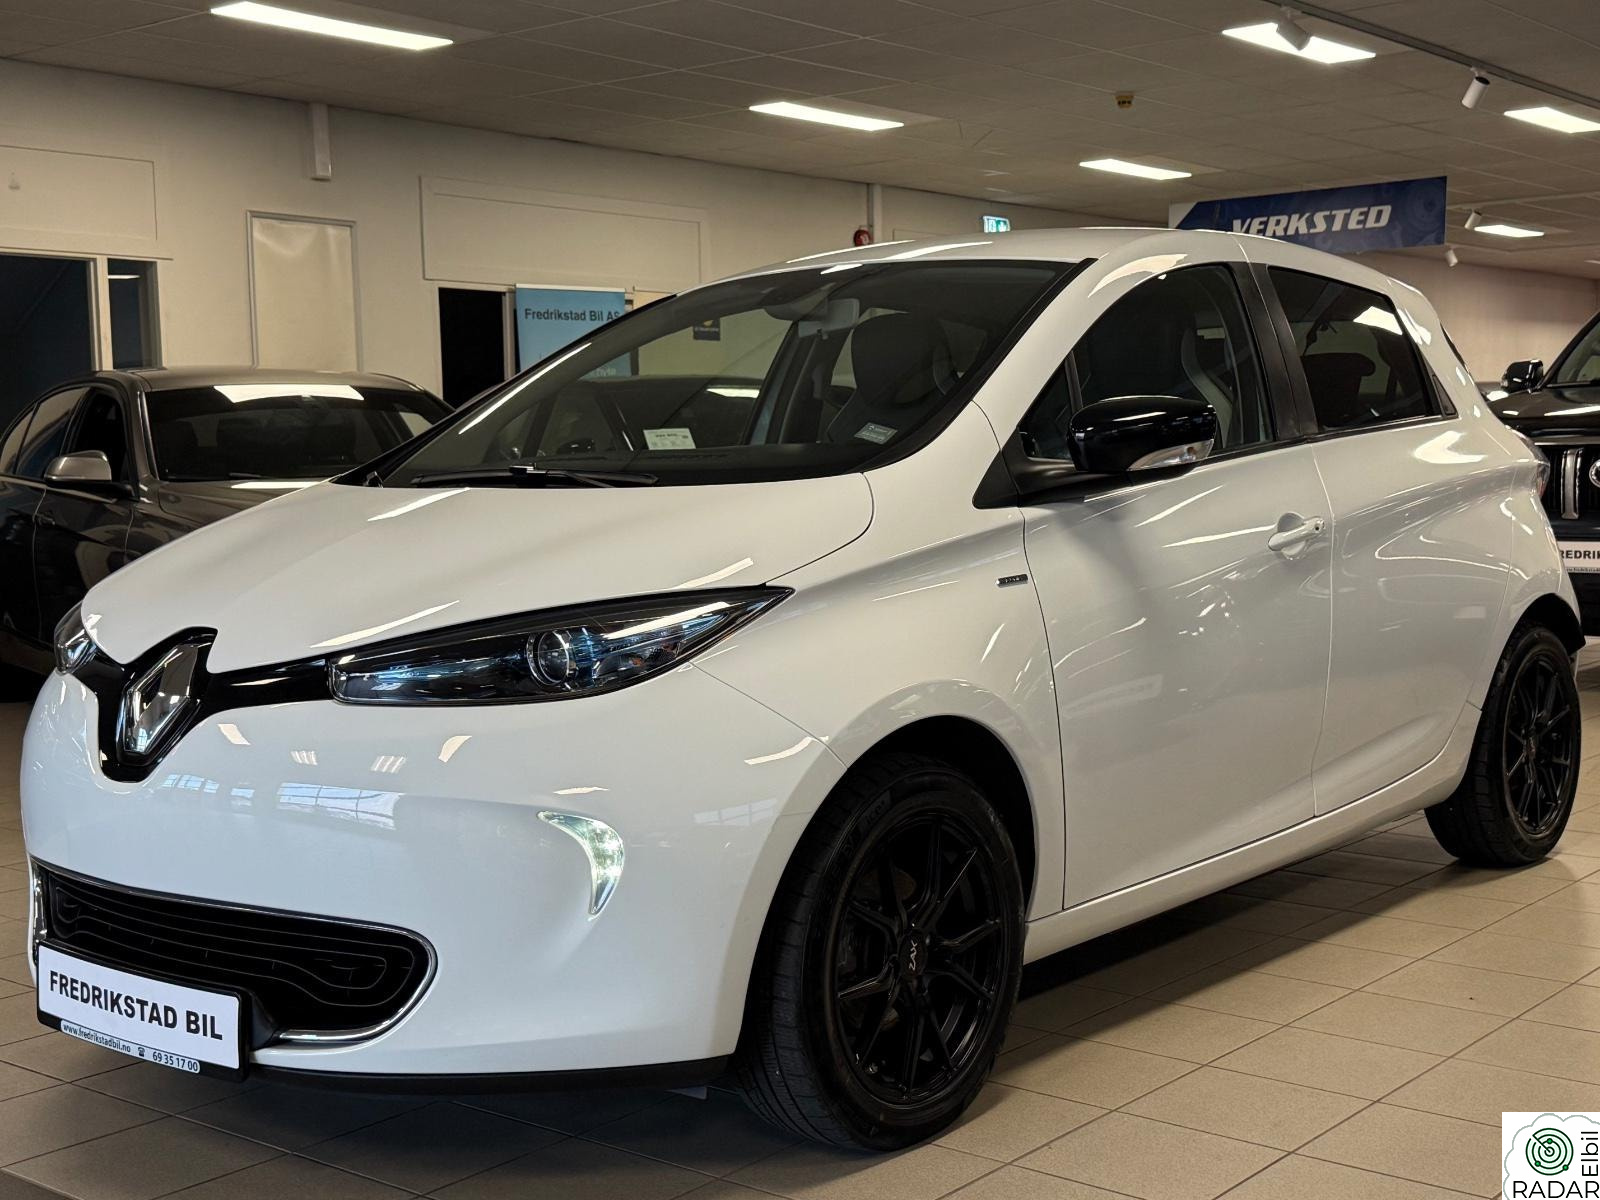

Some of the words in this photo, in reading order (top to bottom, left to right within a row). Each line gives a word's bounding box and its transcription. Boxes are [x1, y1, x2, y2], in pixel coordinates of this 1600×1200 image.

[1232, 204, 1392, 237] VERKSTED
[524, 308, 586, 321] Fredrikstad
[589, 310, 604, 321] Bil
[607, 311, 620, 321] AS
[50, 970, 177, 1029] FREDRIKSTAD
[186, 1010, 223, 1041] BIL
[63, 1023, 131, 1053] www.fredrikstadbil.no
[152, 1051, 163, 1063] 69
[164, 1055, 174, 1066] 35
[176, 1058, 186, 1069] 17
[187, 1061, 198, 1072] 00
